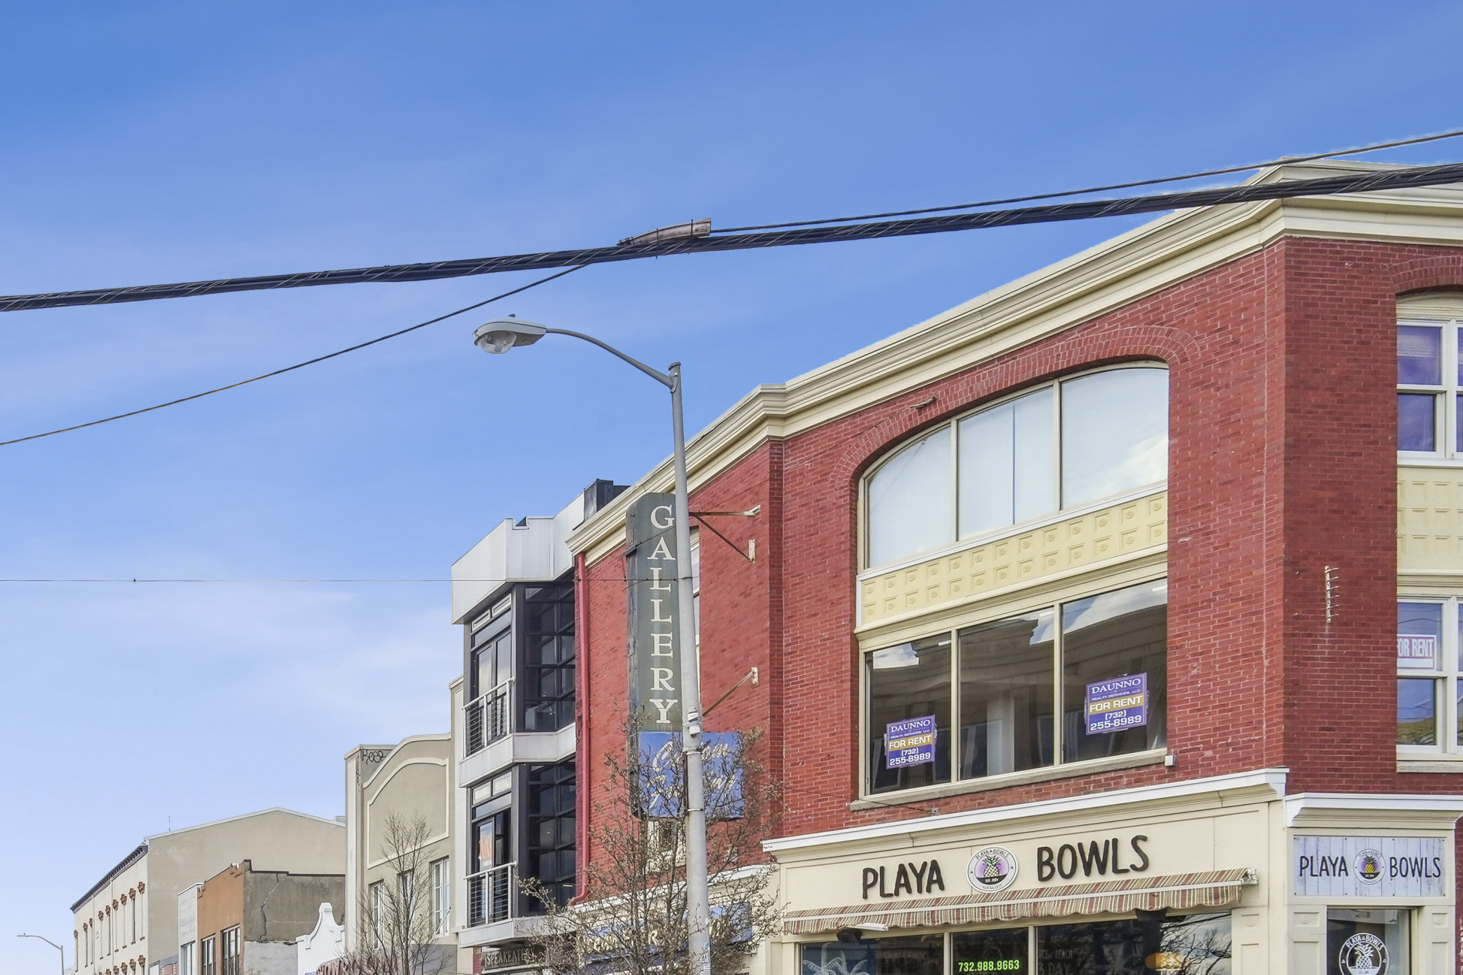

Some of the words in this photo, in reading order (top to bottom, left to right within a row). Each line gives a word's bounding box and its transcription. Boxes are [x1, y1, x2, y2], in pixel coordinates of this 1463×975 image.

[647, 504, 679, 724] GALLERY
[1397, 638, 1410, 657] OR
[1411, 638, 1434, 657] RENT
[1091, 678, 1142, 694] DAUNNO
[1089, 702, 1111, 713] FOR
[1113, 696, 1143, 708] RENT
[890, 719, 931, 733] DAUNNO
[1090, 715, 1142, 731] 255-8989
[889, 740, 906, 749] FOR
[908, 735, 932, 746] RENT
[889, 752, 931, 766] 255-8989
[862, 859, 946, 899] PLAYA
[1037, 834, 1150, 882] BOWLS
[1299, 855, 1349, 877] PLAYA
[1389, 856, 1442, 878] BOWLS
[1345, 934, 1363, 950] PLAYA
[1365, 933, 1385, 951] BOWLS
[958, 960, 1020, 973] 732.988.9663
